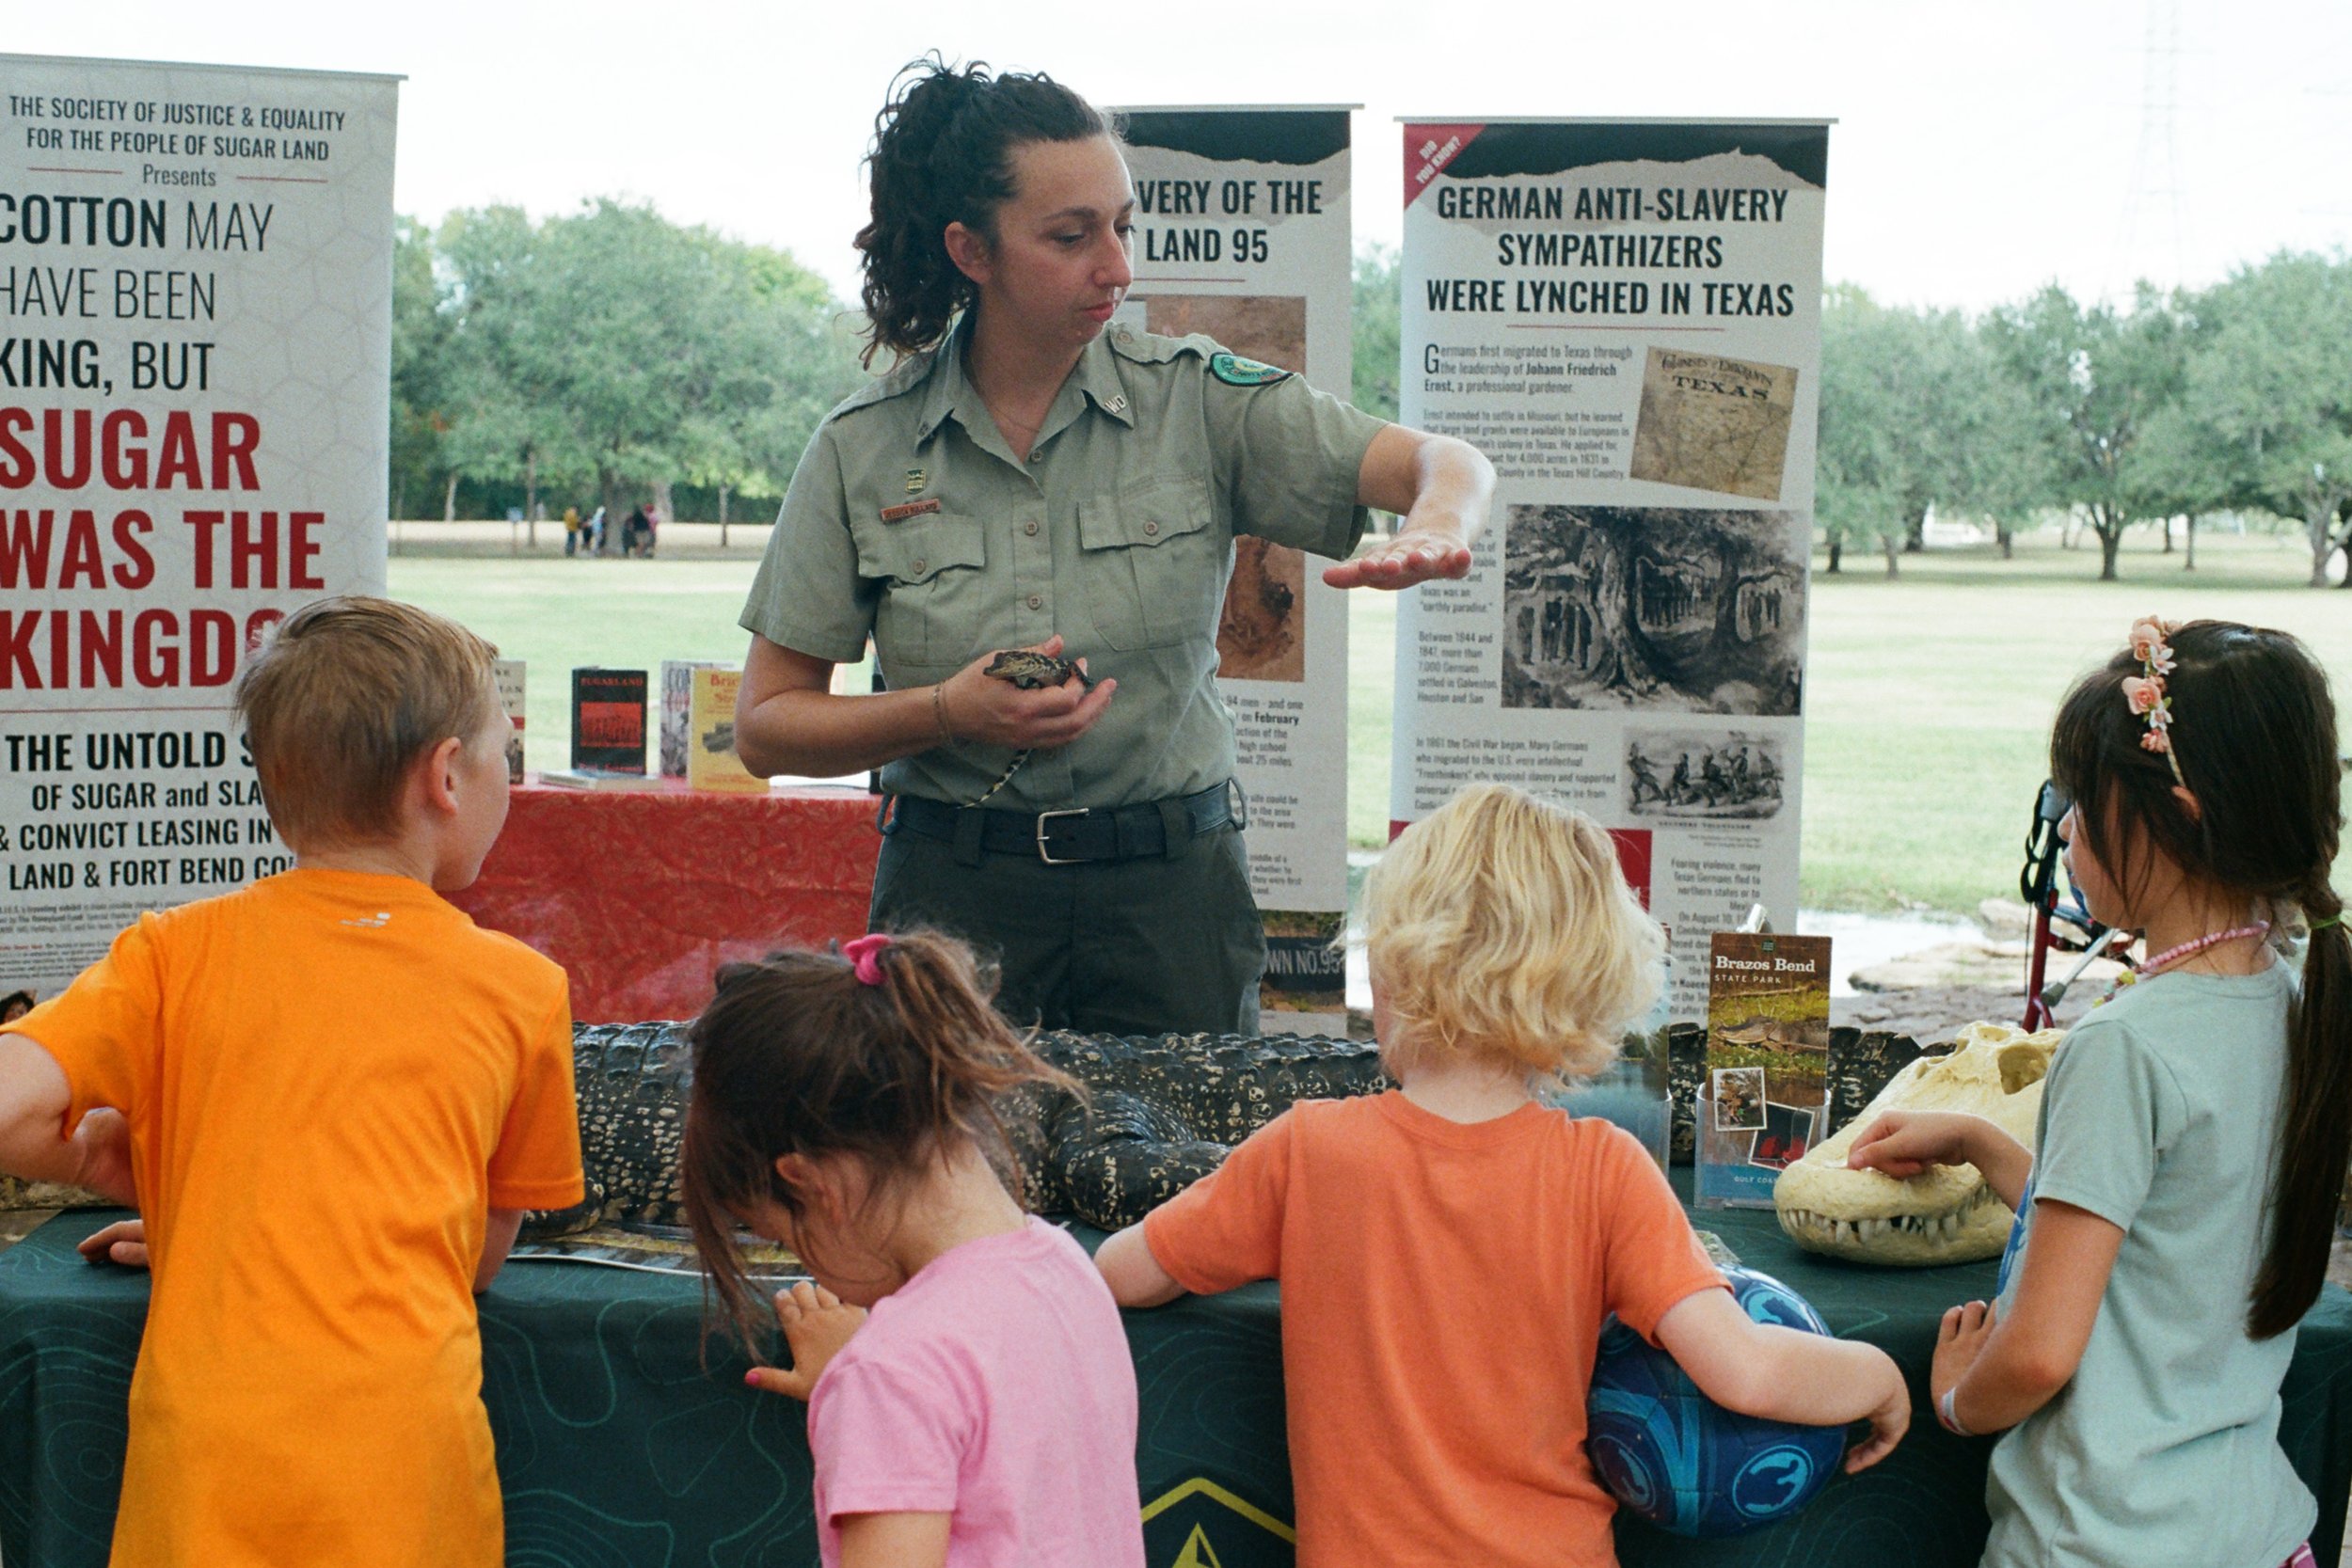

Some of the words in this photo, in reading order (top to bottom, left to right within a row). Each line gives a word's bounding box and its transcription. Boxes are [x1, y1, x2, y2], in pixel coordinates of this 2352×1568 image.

[10, 95, 44, 118] THE
[52, 97, 128, 121] SOCIETY
[134, 101, 157, 123] OF
[162, 103, 234, 127] JUSTICE
[242, 105, 254, 128] &
[261, 107, 345, 131] EQUALITY
[26, 128, 63, 150] FOR
[71, 129, 103, 151] THE
[110, 131, 178, 155] PEOPLE
[184, 135, 207, 156] OF
[214, 136, 276, 159] SUGAR
[282, 140, 329, 161] LAND
[1415, 164, 1436, 184] YOU
[1431, 135, 1461, 167] KNOW?
[1419, 140, 1438, 160] DID
[143, 164, 216, 186] Presents
[1223, 181, 1257, 214] OF
[1266, 181, 1322, 214] THE
[1437, 186, 1563, 220] GERMAN
[1574, 187, 1788, 222] ANTI-SLAVERY
[0, 194, 166, 248] COTTON
[187, 201, 274, 251] MAY
[1146, 229, 1221, 262] LAND
[1232, 229, 1268, 262] 95
[1498, 234, 1723, 268] SYMPATHIZERS
[115, 270, 215, 320] BEEN
[1426, 279, 1505, 312] WERE
[1516, 280, 1648, 315] LYNCHED
[1661, 282, 1690, 315] IN
[1702, 283, 1794, 317] TEXAS
[0, 339, 112, 396] KING,
[132, 341, 215, 390] BUT
[1480, 344, 1500, 358] first
[1503, 345, 1548, 360] migrated
[1551, 346, 1560, 358] to
[1564, 345, 1590, 358] Texas
[1594, 346, 1632, 361] through
[1440, 363, 1456, 375] the
[1459, 363, 1511, 377] leadership
[1513, 363, 1524, 376] of
[1526, 363, 1564, 376] Johann
[1567, 363, 1616, 376] Friedrich
[1424, 379, 1454, 393] Ernst,
[1466, 380, 1526, 395] professional
[1673, 375, 1771, 401] TEXAS
[0, 406, 261, 490] SUGAR
[0, 509, 155, 590] WAS
[183, 511, 325, 590] THE
[1255, 710, 1299, 726] February
[6, 734, 72, 772] THE
[87, 731, 226, 769] UNTOLD
[32, 784, 61, 811] OF
[72, 782, 156, 810] SUGAR
[166, 781, 209, 806] and
[20, 821, 127, 851] CONVICT
[137, 818, 239, 848] LEASING
[248, 817, 272, 845] IN
[9, 863, 73, 891] LAND
[84, 862, 101, 888] &
[109, 859, 169, 887] FORT
[180, 856, 245, 884] BEND
[1714, 974, 1747, 983] STATE
[1753, 975, 1782, 984] PARK
[1715, 956, 1770, 971] Brazos
[1774, 958, 1816, 973] Bend
